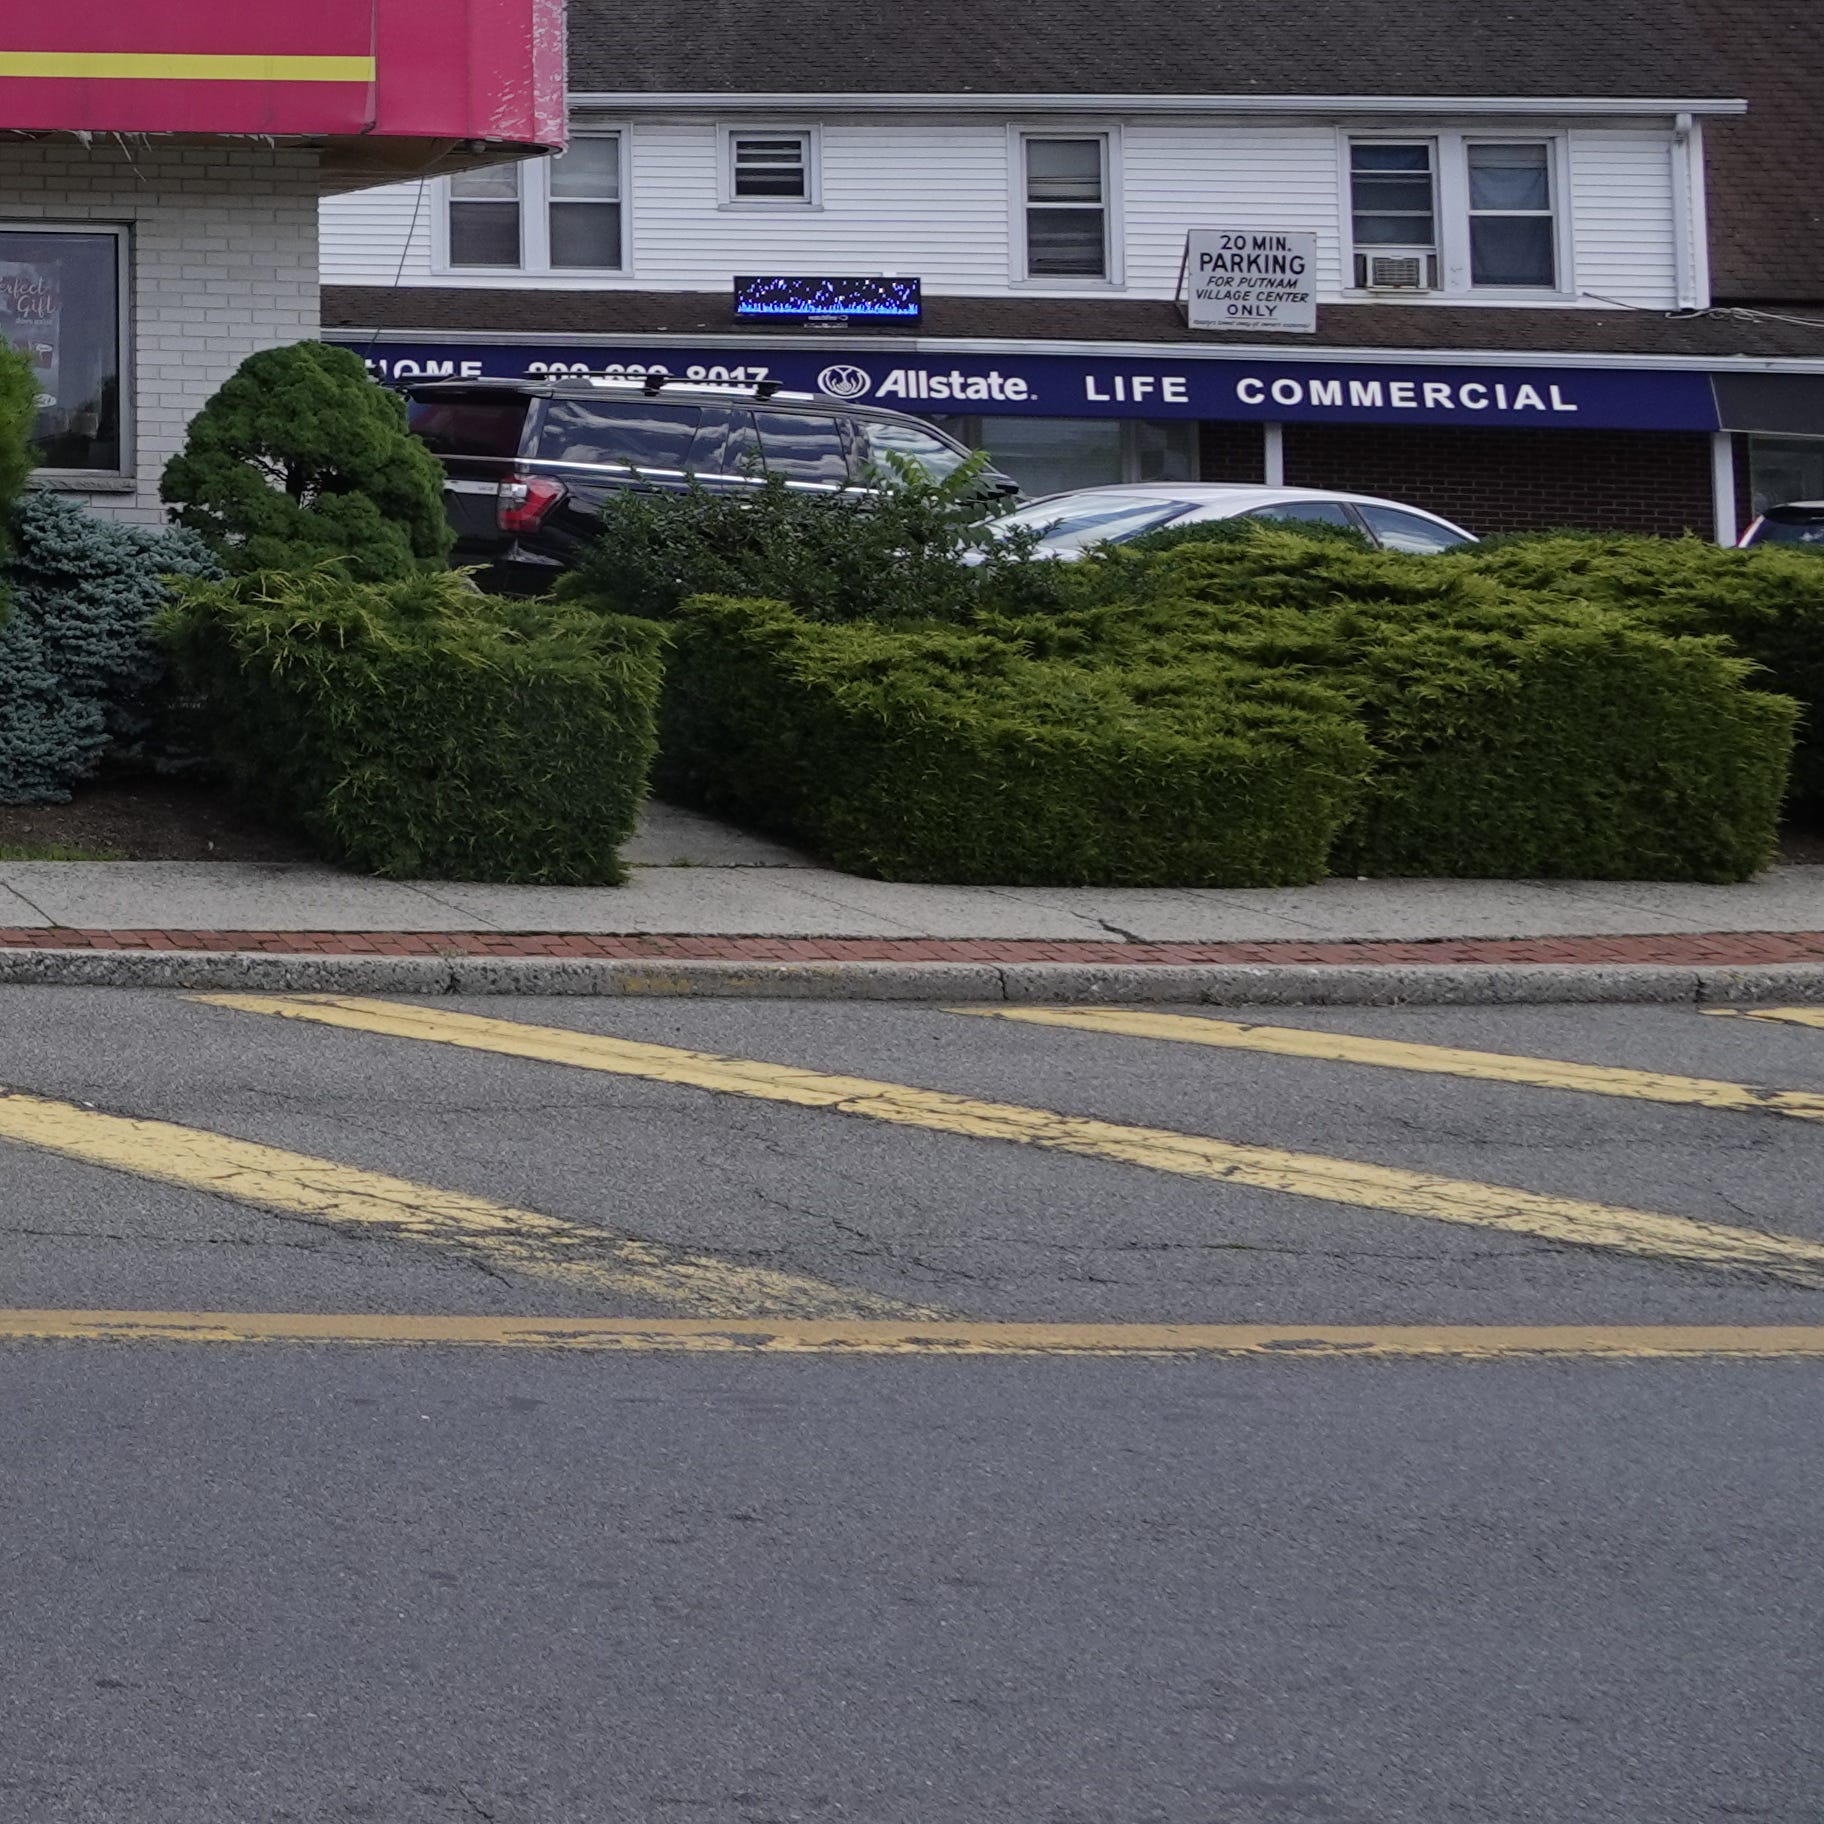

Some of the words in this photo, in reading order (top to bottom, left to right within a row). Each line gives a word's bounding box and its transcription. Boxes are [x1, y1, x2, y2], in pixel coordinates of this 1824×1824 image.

[1220, 235, 1246, 251] 20
[1253, 236, 1292, 252] MIN.
[1199, 252, 1306, 275] PARKING
[1206, 276, 1235, 288] FOR
[1237, 277, 1298, 289] PUTNAM
[1196, 289, 1251, 302] VILLAGE
[1255, 291, 1310, 304] CENTER
[16, 294, 58, 319] Gift
[1227, 304, 1278, 317] ONLY
[875, 369, 1029, 400] Allstate
[1085, 375, 1190, 403] LIFE
[1236, 377, 1579, 411] COMMERCIAL
